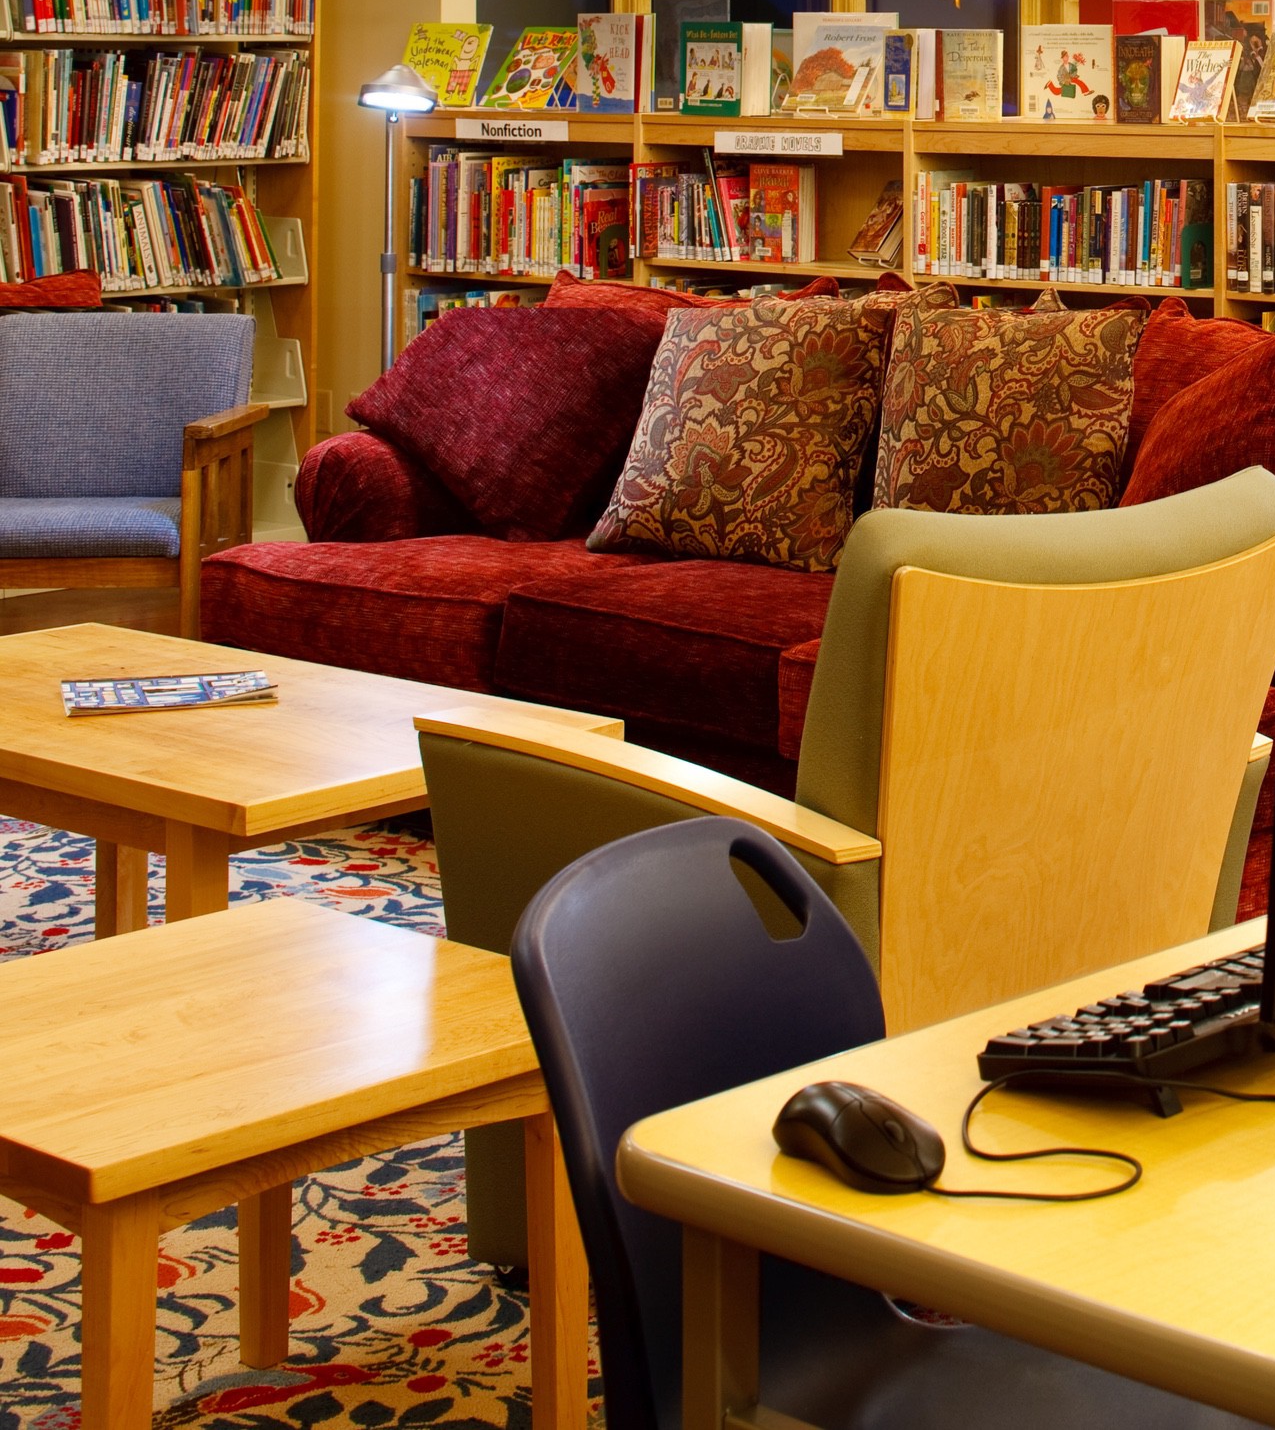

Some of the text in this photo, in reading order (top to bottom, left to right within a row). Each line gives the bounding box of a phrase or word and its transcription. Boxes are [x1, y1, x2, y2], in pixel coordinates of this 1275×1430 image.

[610, 24, 629, 35] KICK
[824, 33, 877, 43] Robert Frost
[411, 42, 455, 57] Underwear
[609, 48, 630, 59] HEAD
[409, 54, 450, 70] Salesman
[1186, 58, 1223, 73] Witches
[481, 121, 542, 138] Nonfiction
[735, 135, 822, 152] GRAPHIC NOVELS
[597, 209, 618, 223] Real
[135, 210, 151, 261] ANIMALS
